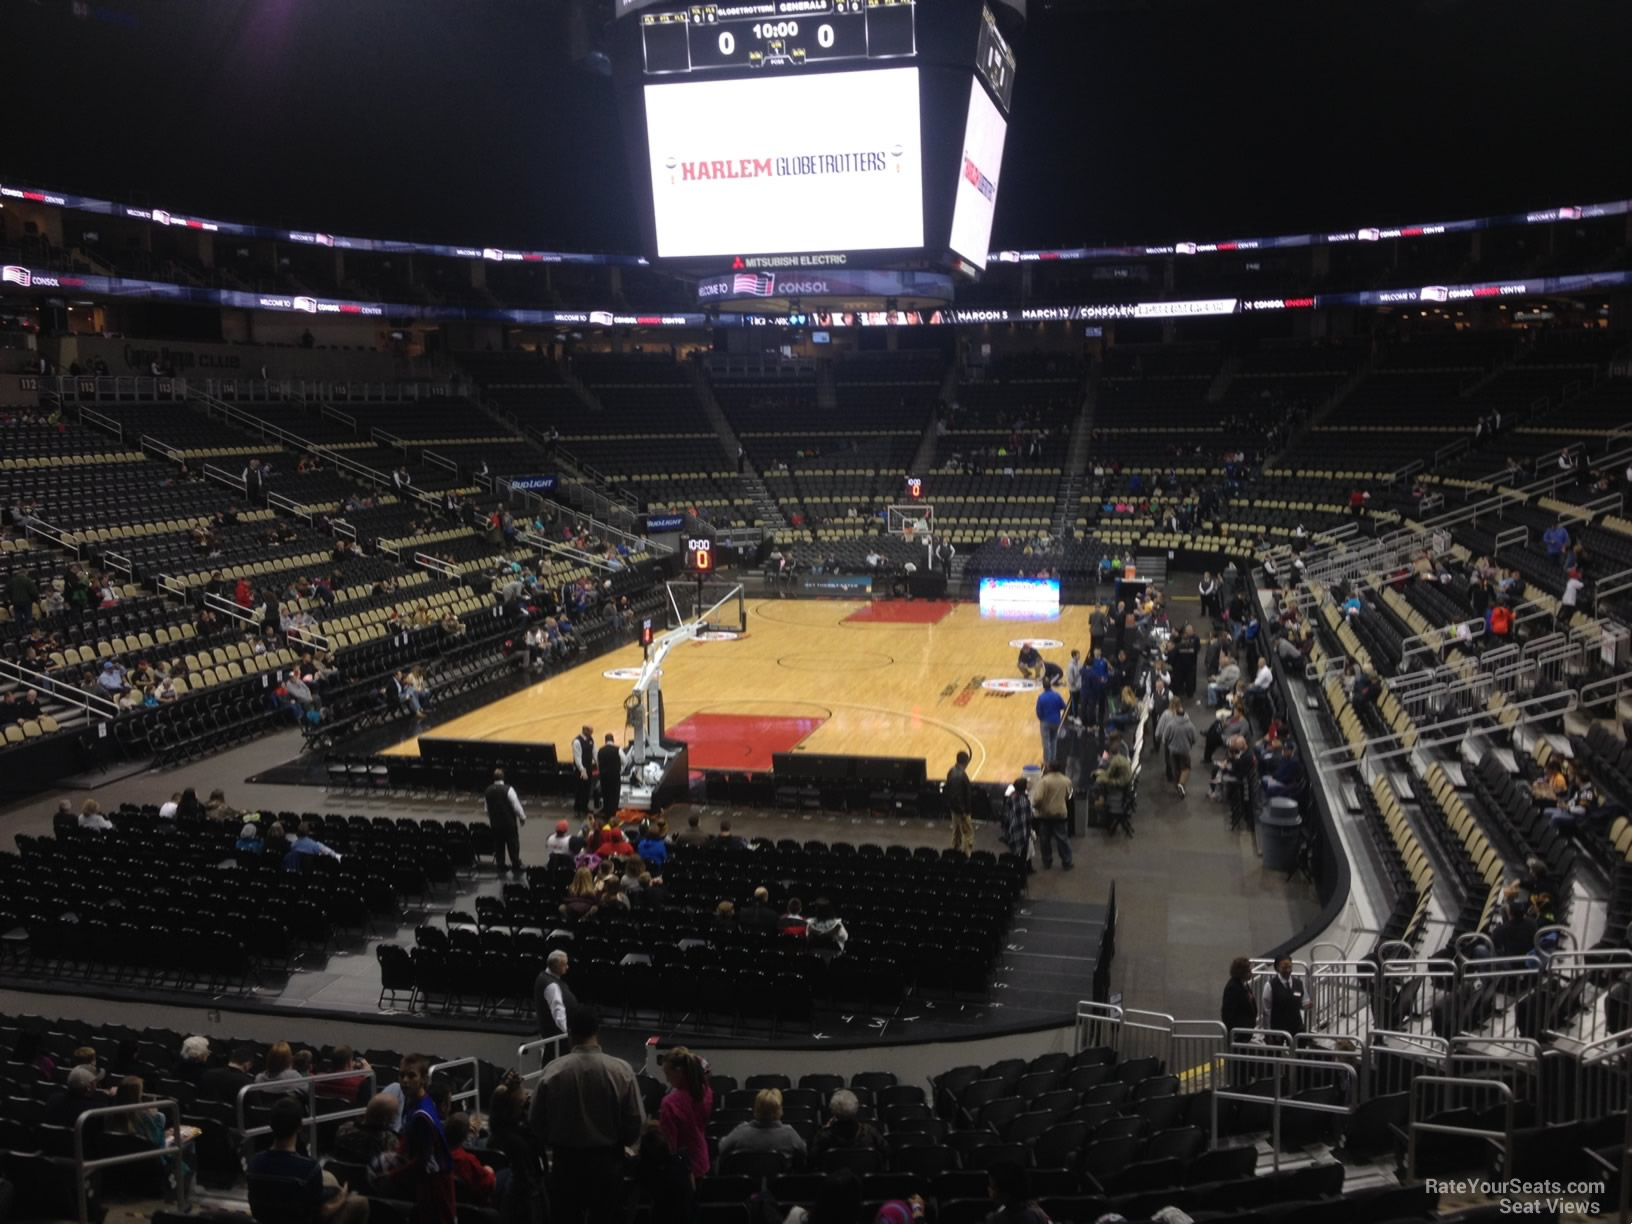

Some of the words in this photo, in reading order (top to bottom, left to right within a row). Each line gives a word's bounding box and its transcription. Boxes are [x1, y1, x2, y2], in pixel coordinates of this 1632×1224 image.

[717, 5, 774, 16] GLOBETROTTERS
[780, 1, 827, 12] GENERALS
[753, 21, 799, 39] 10:00
[818, 24, 835, 48] 0
[718, 31, 735, 55] 0
[681, 158, 773, 181] HARLEM
[776, 152, 887, 176] GLOBETROTTERS
[745, 256, 798, 268] MITSUBISHI
[800, 254, 847, 266] ELECTRIC
[31, 275, 61, 288] CONSOL
[778, 281, 830, 294] CONSOL
[957, 310, 1000, 321] MAROON
[1022, 308, 1057, 319] MARCH
[1059, 307, 1070, 318] 13
[21, 378, 37, 390] 112
[80, 382, 95, 393] 113
[529, 479, 553, 488] LIGHT
[688, 539, 710, 550] 10:00
[697, 550, 708, 568] 0
